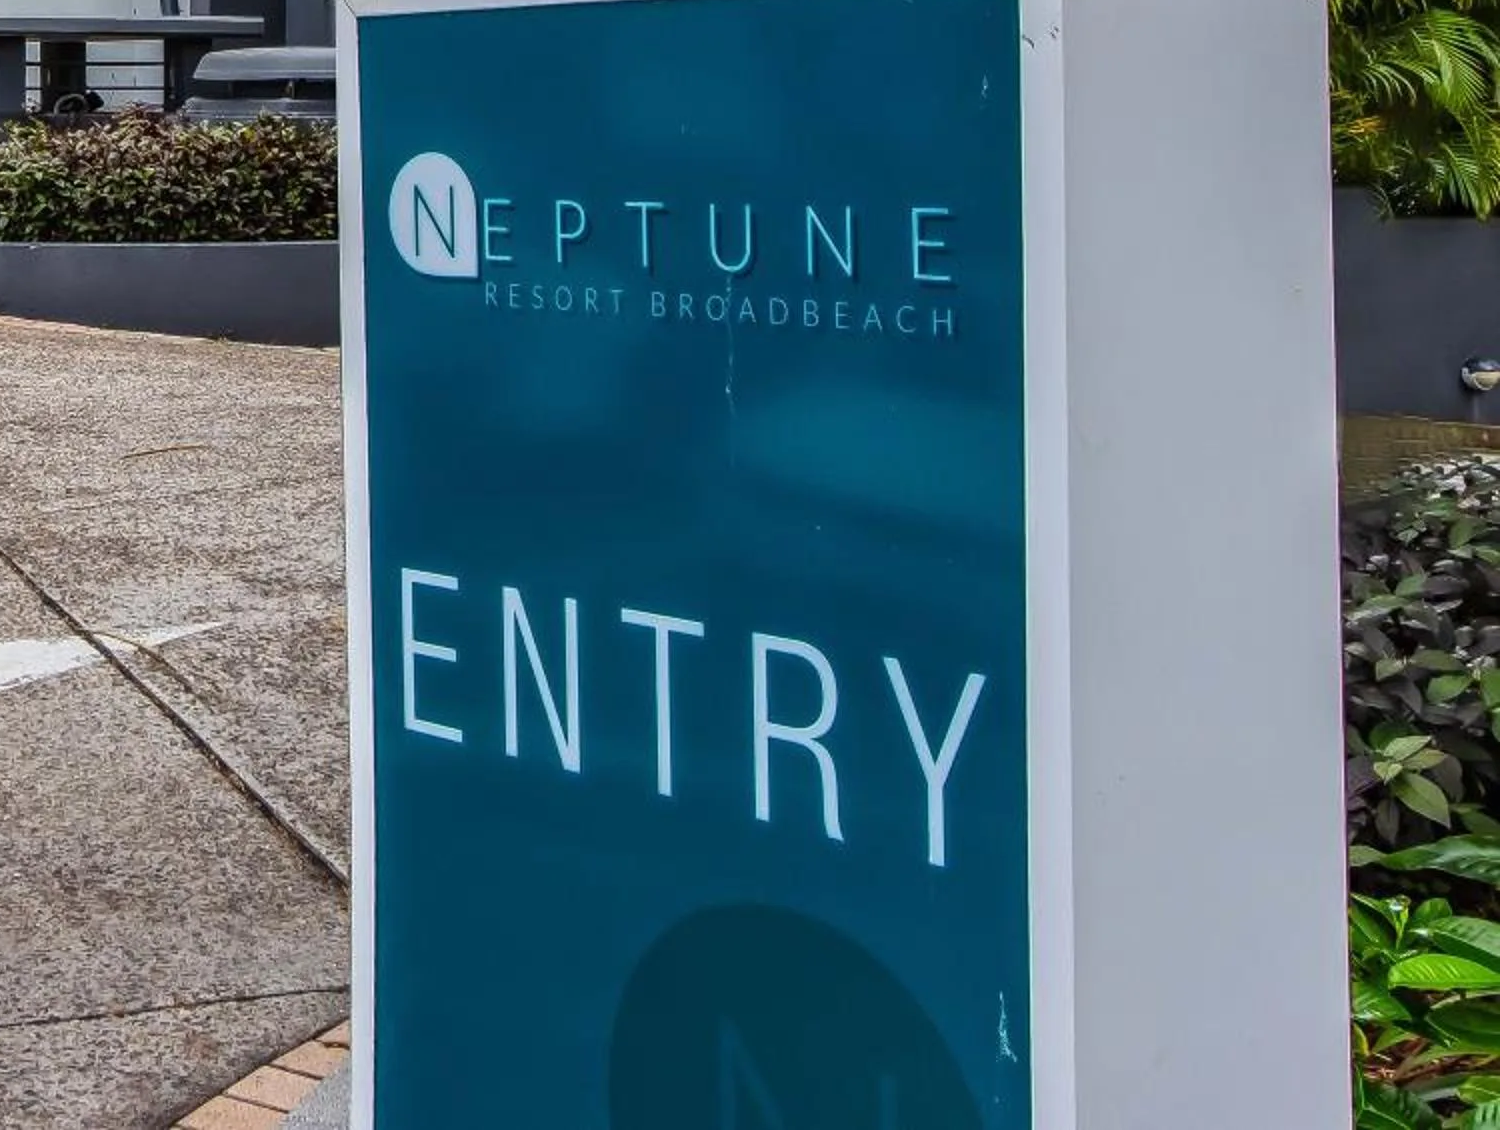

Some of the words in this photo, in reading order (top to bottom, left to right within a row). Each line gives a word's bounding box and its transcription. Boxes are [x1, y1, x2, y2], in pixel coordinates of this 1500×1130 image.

[414, 184, 952, 281] NEPTUNE
[484, 281, 624, 315] RESORT
[651, 291, 956, 338] BROADBEACH
[401, 567, 986, 867] ENTRY
